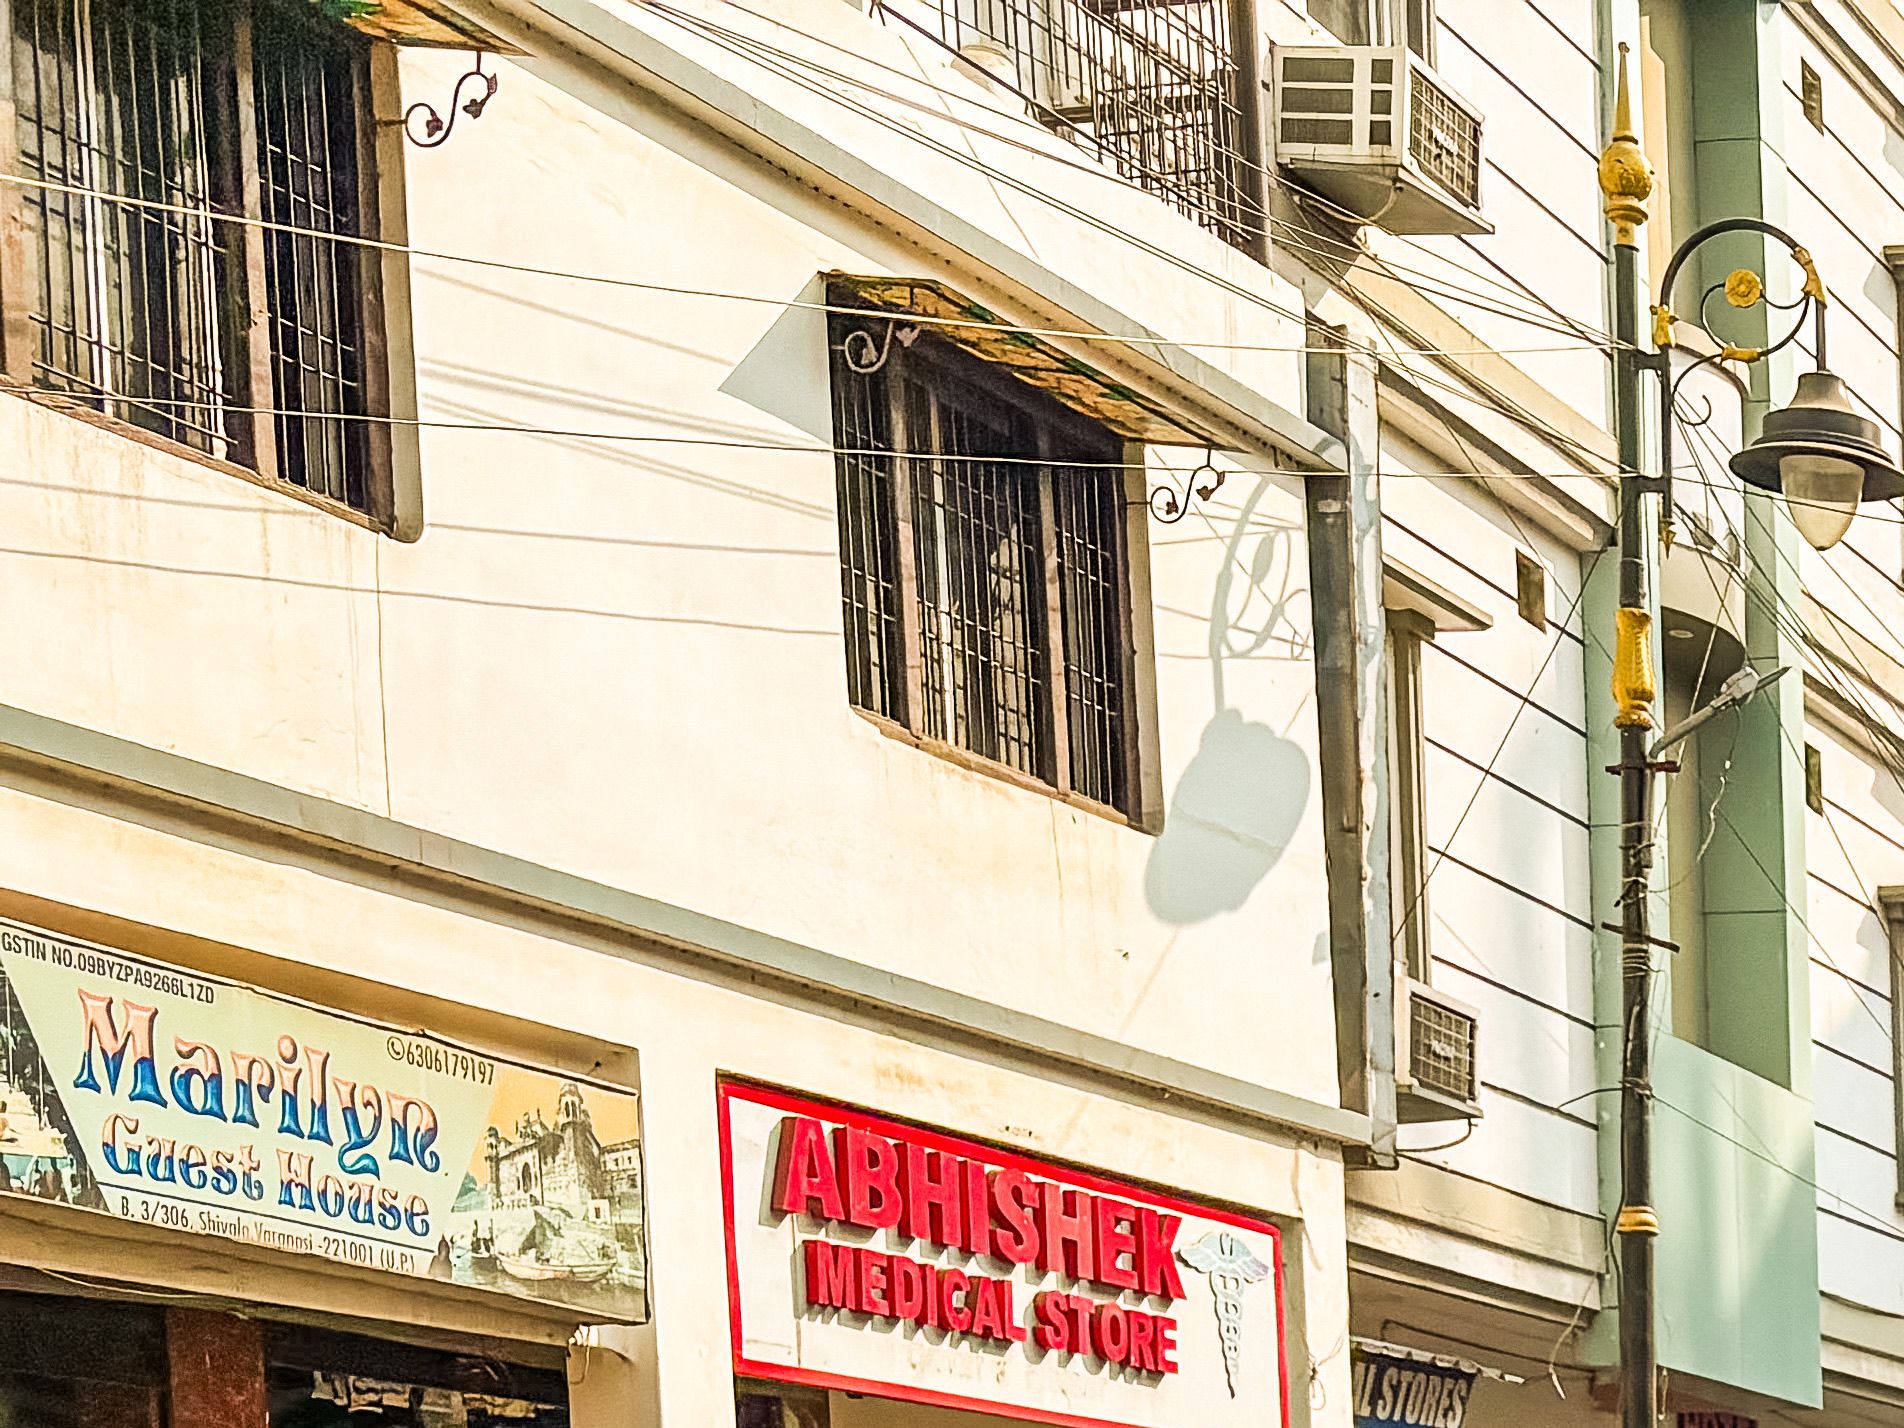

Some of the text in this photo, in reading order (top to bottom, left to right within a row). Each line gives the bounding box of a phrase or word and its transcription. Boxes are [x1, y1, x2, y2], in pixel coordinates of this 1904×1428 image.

[1, 932, 47, 961] GSTIN
[73, 987, 441, 1180] Marilyn
[405, 1046, 496, 1087] 6306179197
[101, 1113, 430, 1238] Guest House
[778, 1115, 1188, 1300] ABHISHEK
[806, 1239, 1180, 1375] MEDICAL STORE
